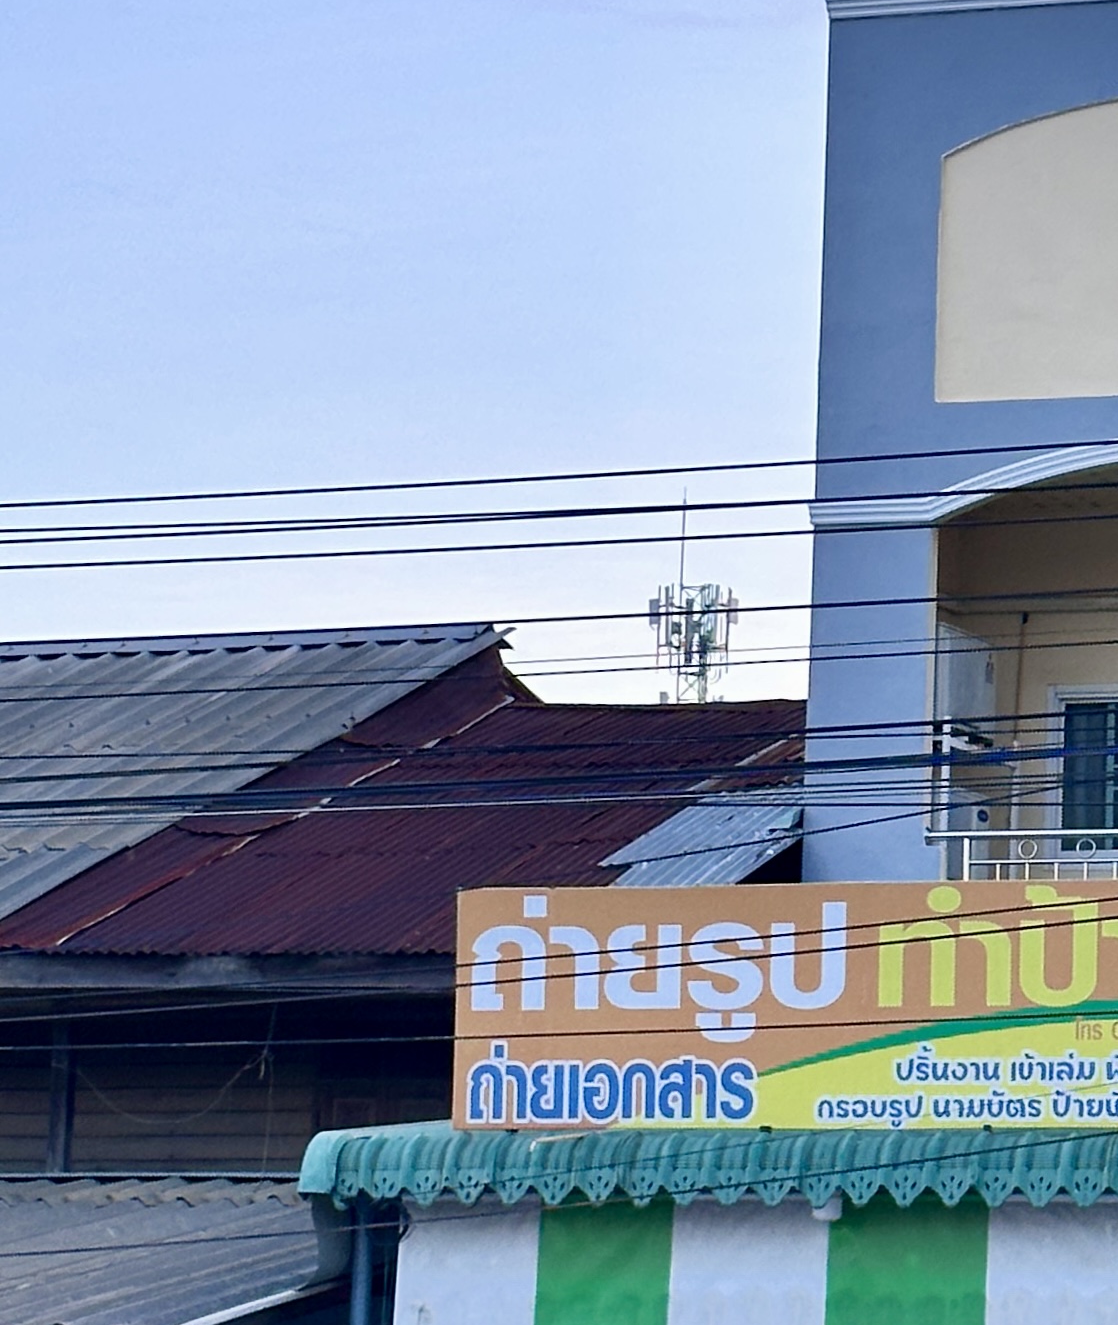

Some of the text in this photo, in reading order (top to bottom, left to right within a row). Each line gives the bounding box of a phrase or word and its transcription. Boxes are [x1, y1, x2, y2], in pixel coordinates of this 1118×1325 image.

[471, 894, 847, 1043] ถ่ายรูป
[1075, 1017, 1103, 1041] โทร
[467, 1043, 756, 1121] ถ่ายเอกสาร
[895, 1046, 1000, 1083] ปริ้นงาน
[1010, 1054, 1096, 1082] เข้าเล่ม
[817, 1094, 922, 1125] กรอบรูป
[933, 1091, 1041, 1119] นามบัตร
